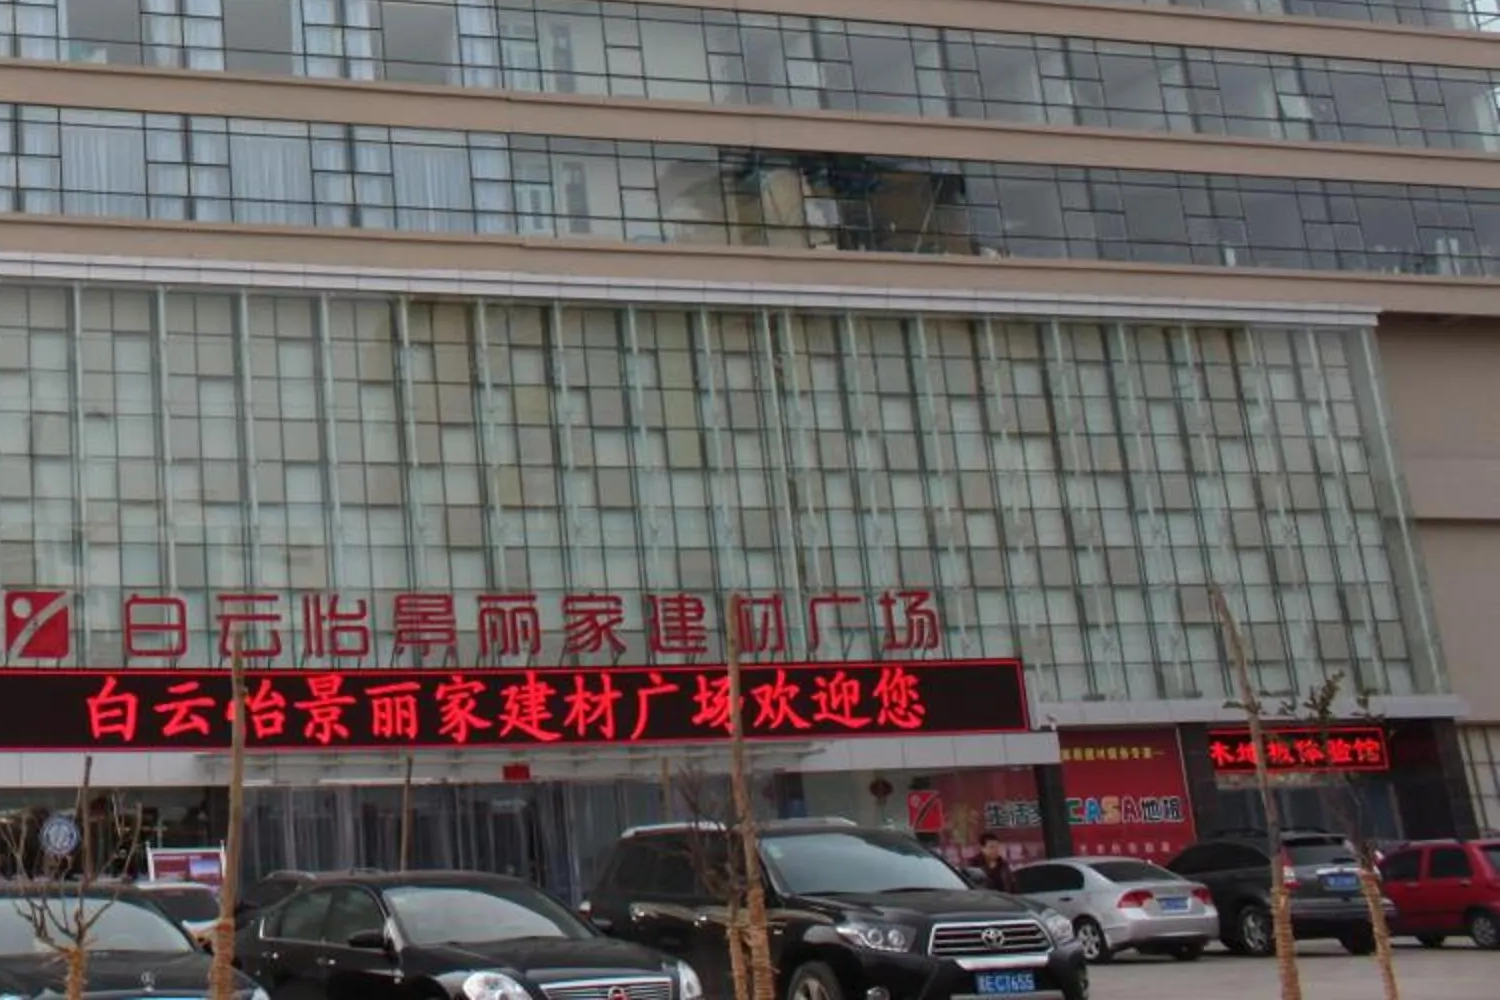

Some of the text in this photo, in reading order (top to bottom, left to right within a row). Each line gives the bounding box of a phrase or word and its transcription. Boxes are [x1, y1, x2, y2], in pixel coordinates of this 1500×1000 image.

[124, 591, 940, 658] 白云怡景丽家建材广场
[87, 666, 927, 744] 白云怡景丽家建材广场欢迎您
